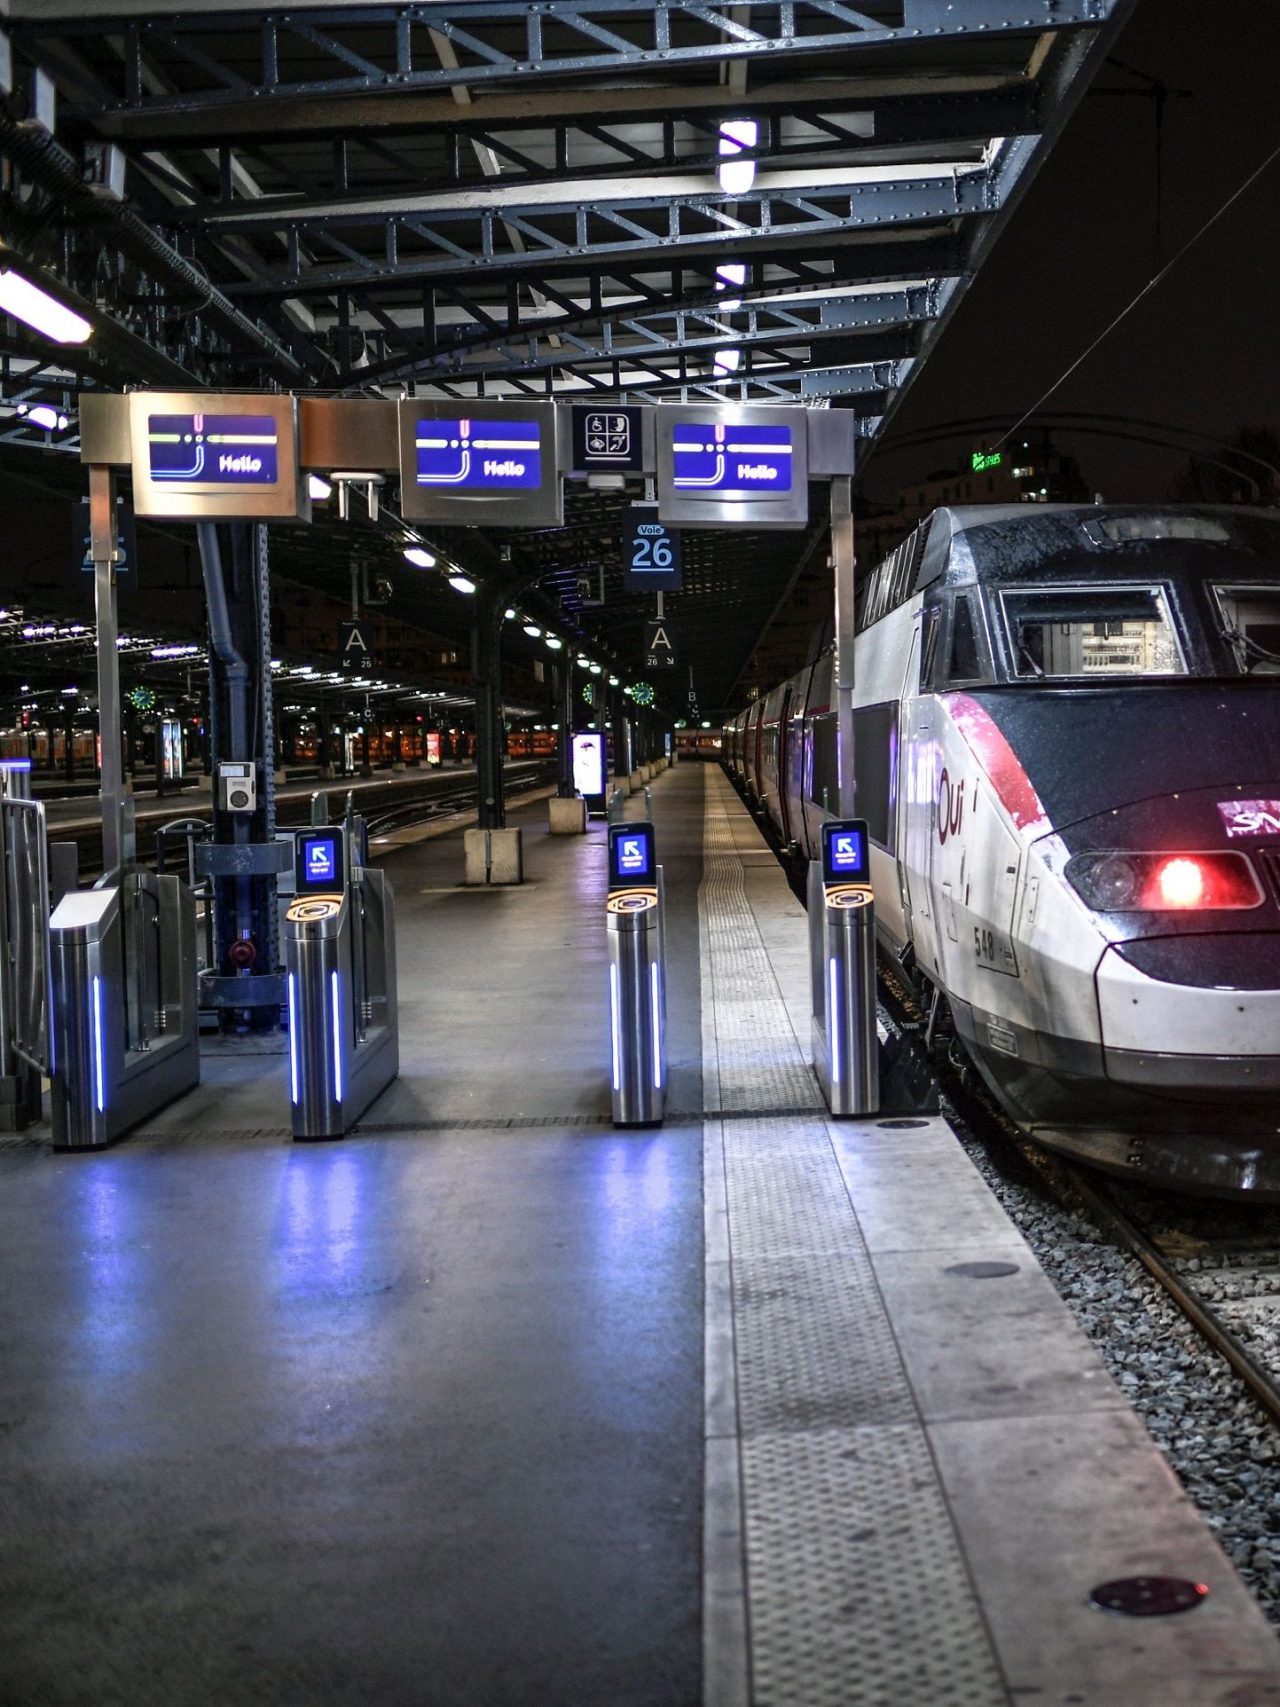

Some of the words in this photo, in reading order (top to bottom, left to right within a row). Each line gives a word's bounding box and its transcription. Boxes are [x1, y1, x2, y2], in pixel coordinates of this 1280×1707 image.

[219, 454, 262, 473] Hello
[483, 460, 525, 477] Hello
[737, 464, 777, 480] Hello
[640, 525, 662, 535] Voie
[632, 538, 673, 567] 26
[345, 628, 368, 652] A
[650, 627, 672, 650] A
[974, 926, 995, 962] 548
